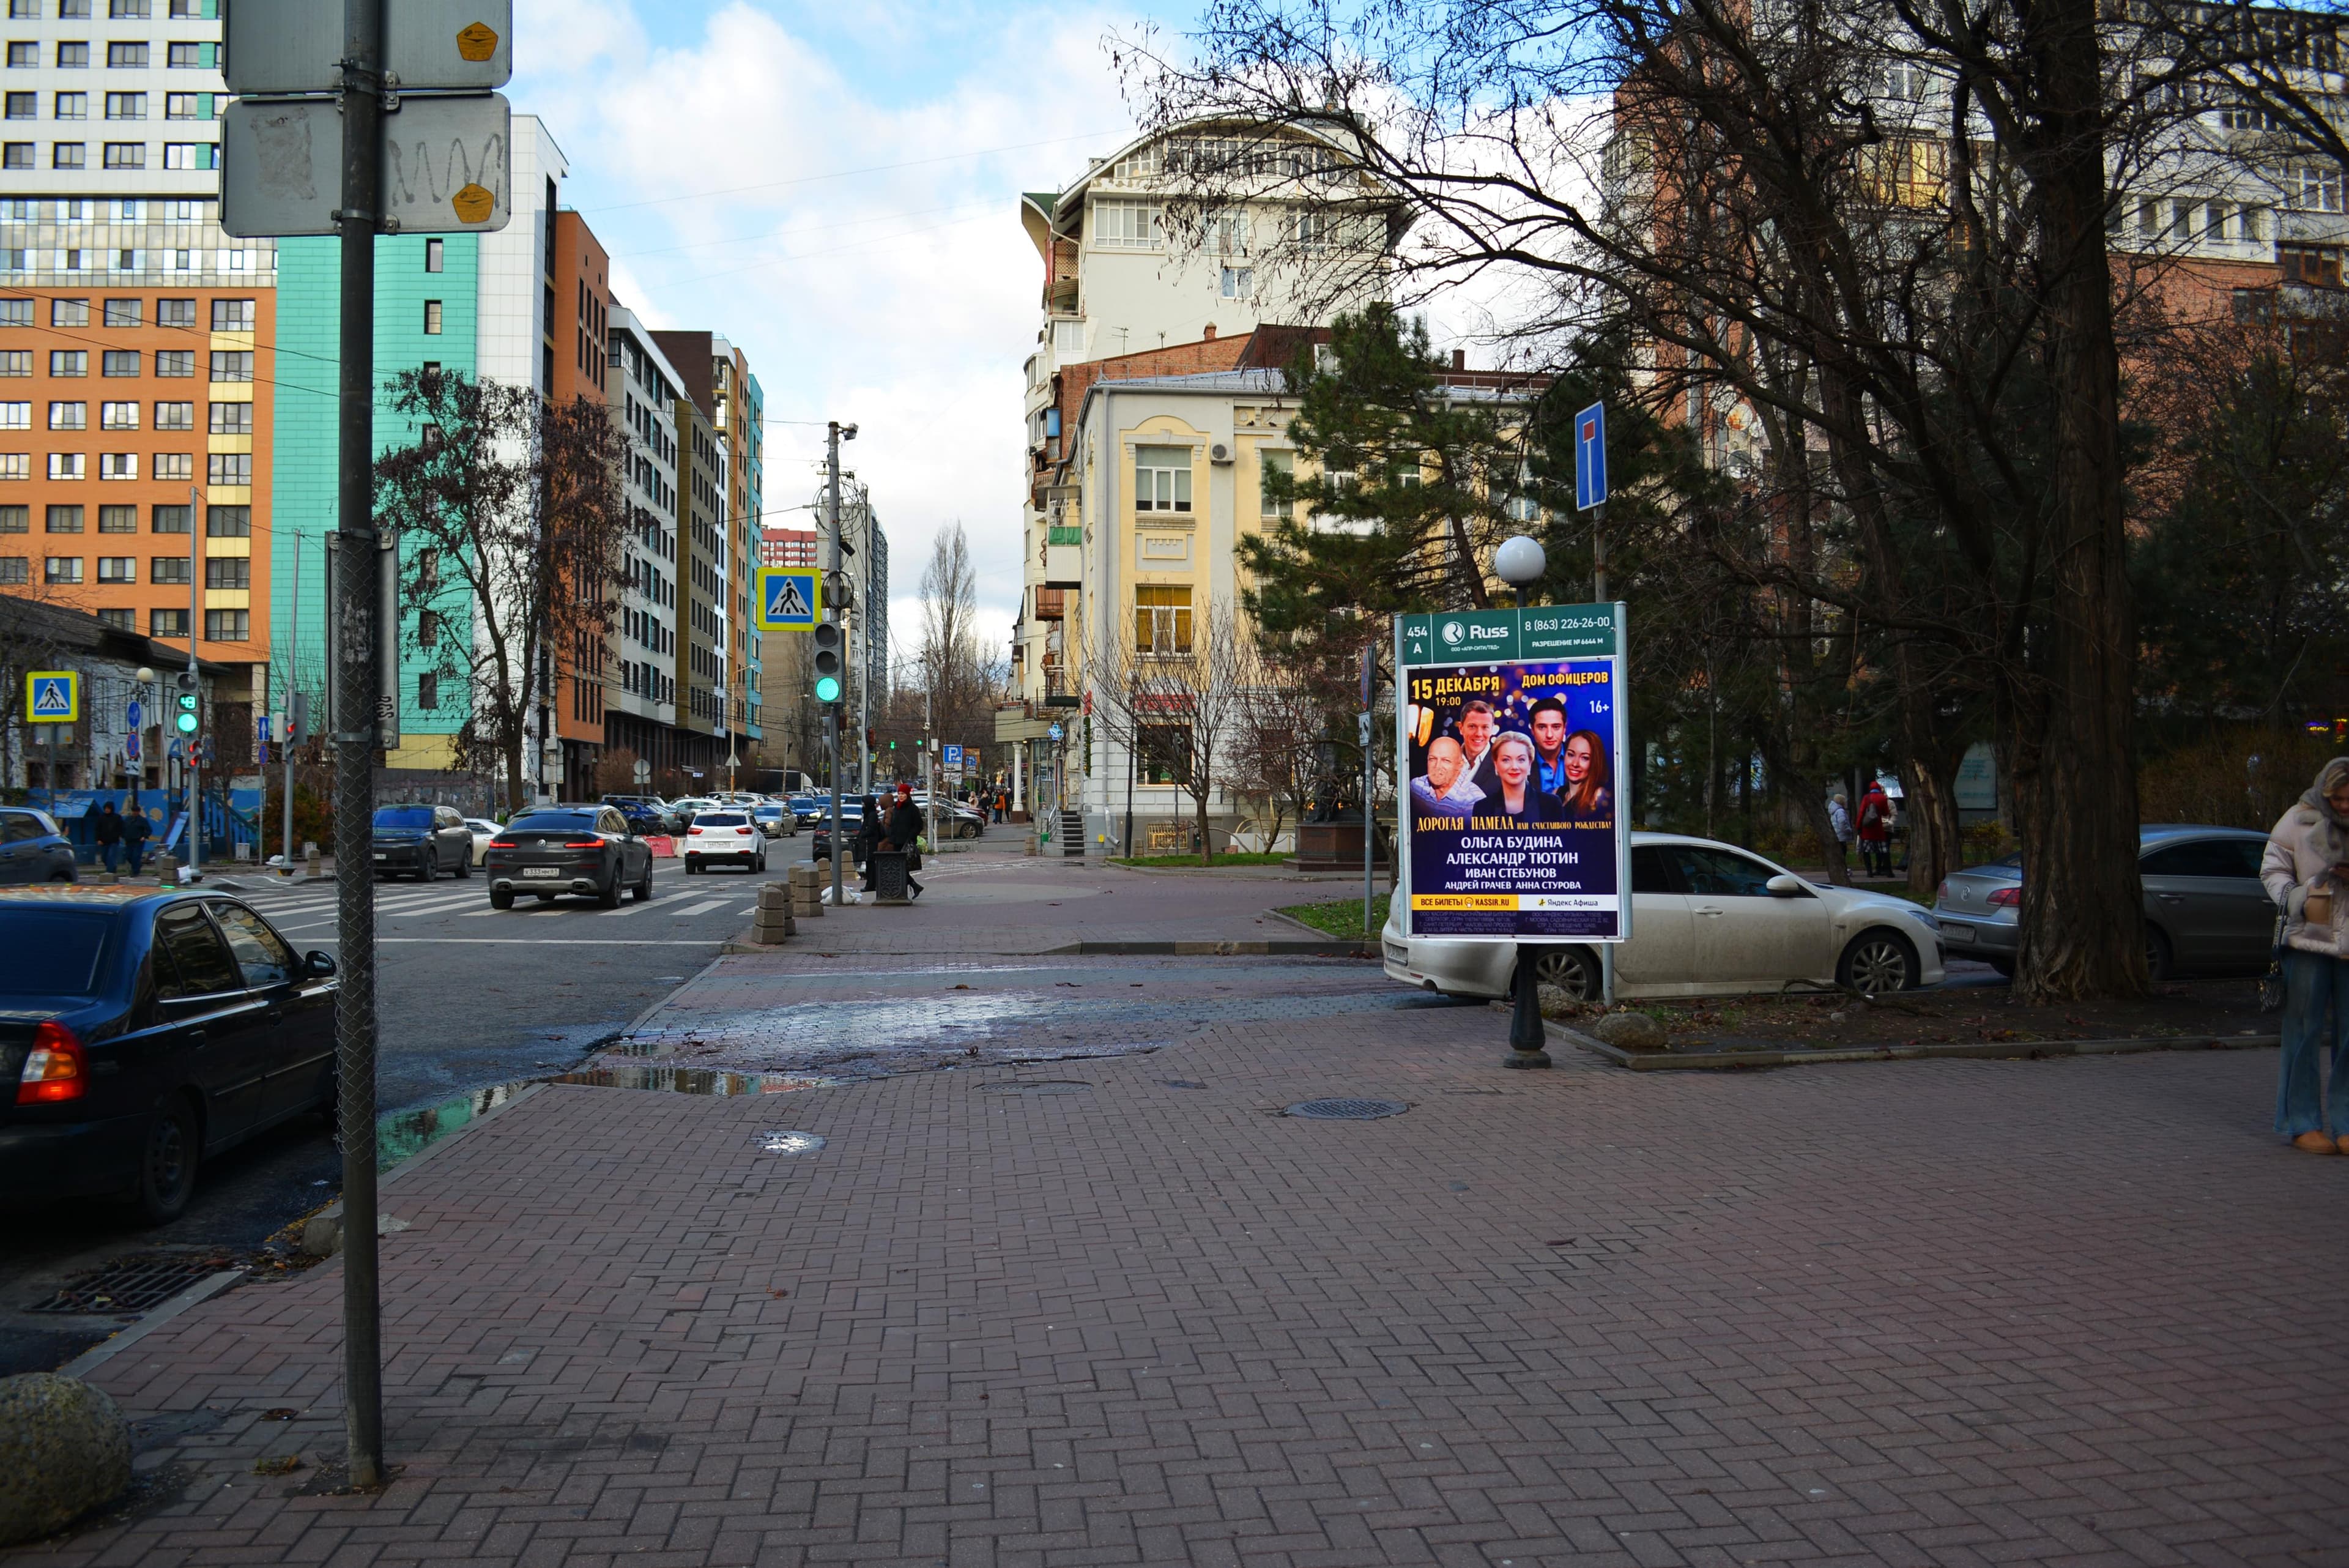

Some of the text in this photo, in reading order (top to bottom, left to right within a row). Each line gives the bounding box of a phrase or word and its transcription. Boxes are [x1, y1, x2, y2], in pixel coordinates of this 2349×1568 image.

[1524, 616, 1610, 631] 8 (863) 226-26-00
[1407, 626, 1428, 637] 454
[1471, 625, 1508, 639] Russ
[1522, 672, 1608, 688] ДОМ ОФИЦЕРОВ
[1412, 676, 1500, 699] 15 ДЕКАБРЯ
[1436, 696, 1461, 706] 19:00
[1590, 700, 1609, 713] 16+
[1417, 817, 1463, 831] ДОРОГАЯ
[1471, 816, 1513, 830] ПАМЕЛА
[1461, 836, 1562, 850] ОЛЬГА БУДИНА
[1447, 853, 1578, 866] АЛЕКСАНДР ТЮТИН
[1465, 868, 1557, 879] ИВАН СТЕБУНОВ
[1445, 880, 1581, 890] АНДРЕЙ ГРАЧЕВ АННА СТУРОВА
[1573, 899, 1598, 907] Афиша
